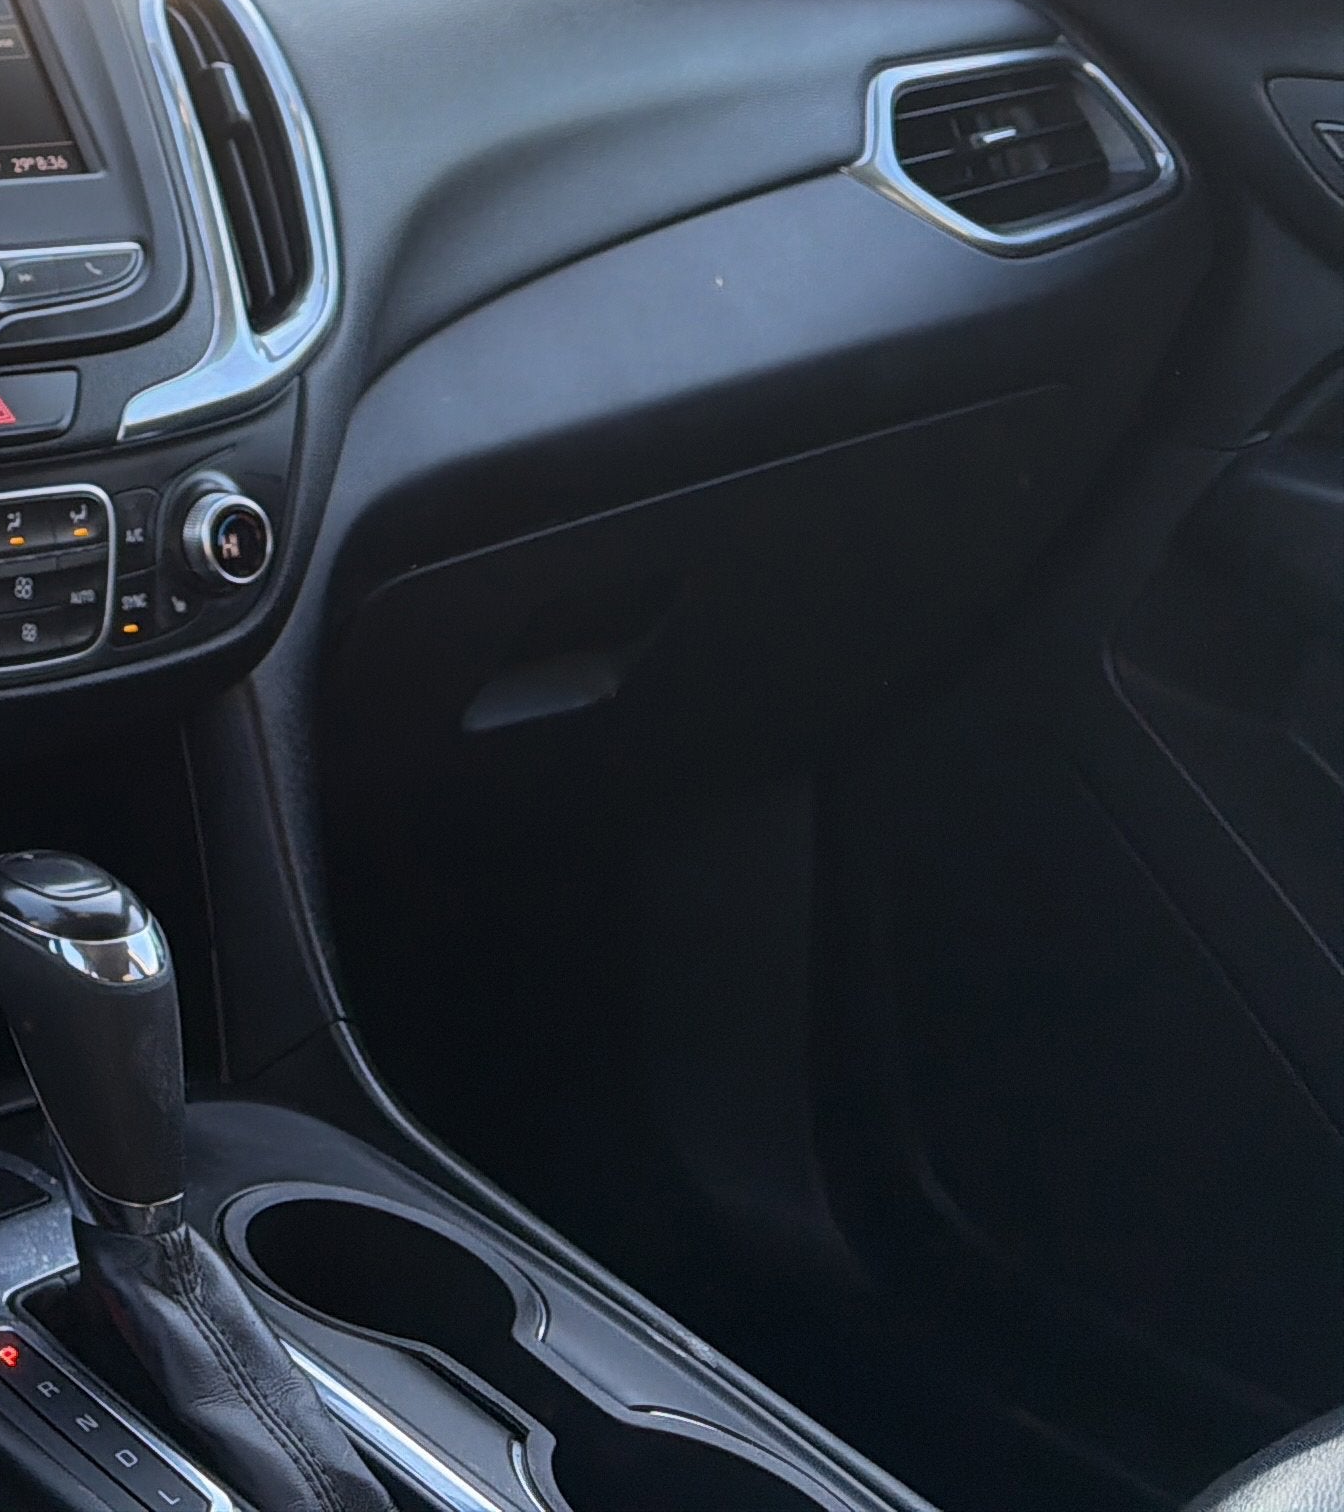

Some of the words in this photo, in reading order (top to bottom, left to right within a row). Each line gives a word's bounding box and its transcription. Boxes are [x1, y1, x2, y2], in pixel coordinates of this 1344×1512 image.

[70, 589, 97, 604] AUTO
[121, 592, 148, 611] SYNC
[37, 1379, 61, 1398] R
[75, 1414, 99, 1433] N
[114, 1449, 139, 1469] D
[157, 1488, 181, 1506] L
